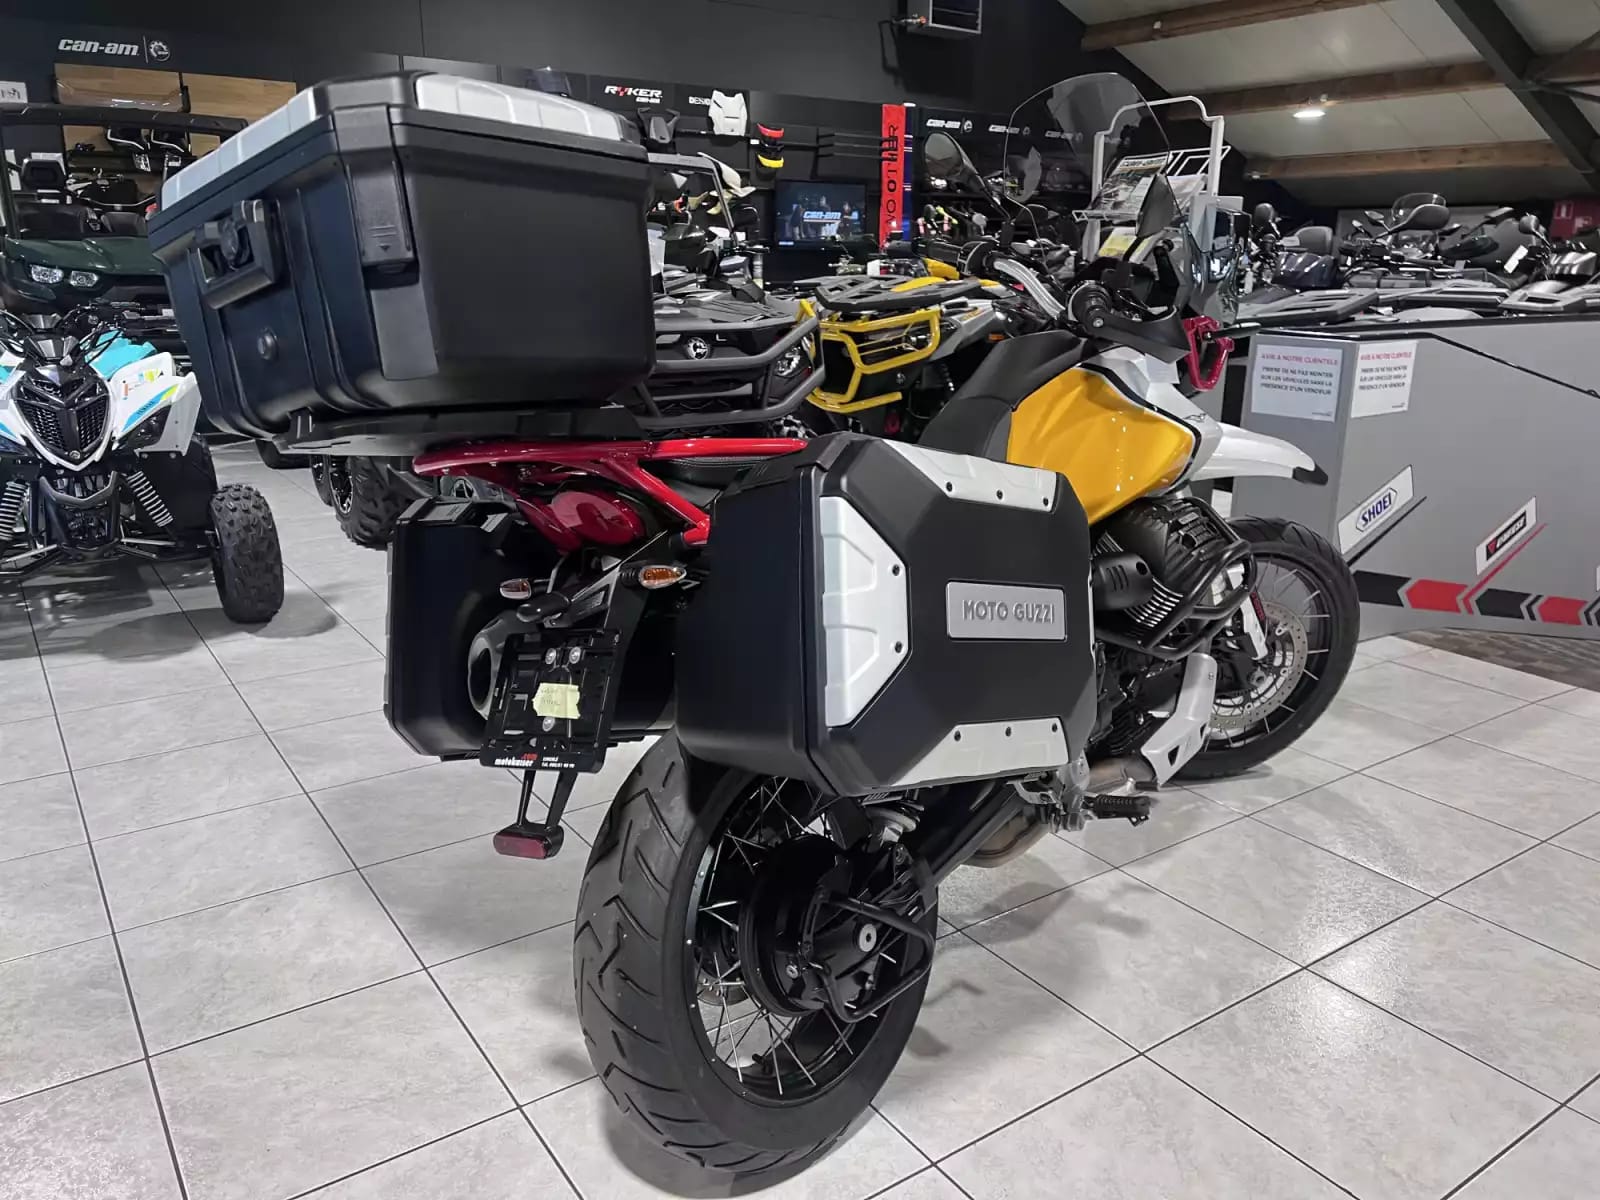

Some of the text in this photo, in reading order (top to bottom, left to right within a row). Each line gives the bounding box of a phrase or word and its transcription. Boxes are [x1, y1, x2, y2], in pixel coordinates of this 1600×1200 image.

[58, 39, 139, 56] can-am
[604, 85, 662, 98] RYKER
[1361, 491, 1392, 528] SHOEI
[962, 599, 1055, 624] MOTO GUZZI
